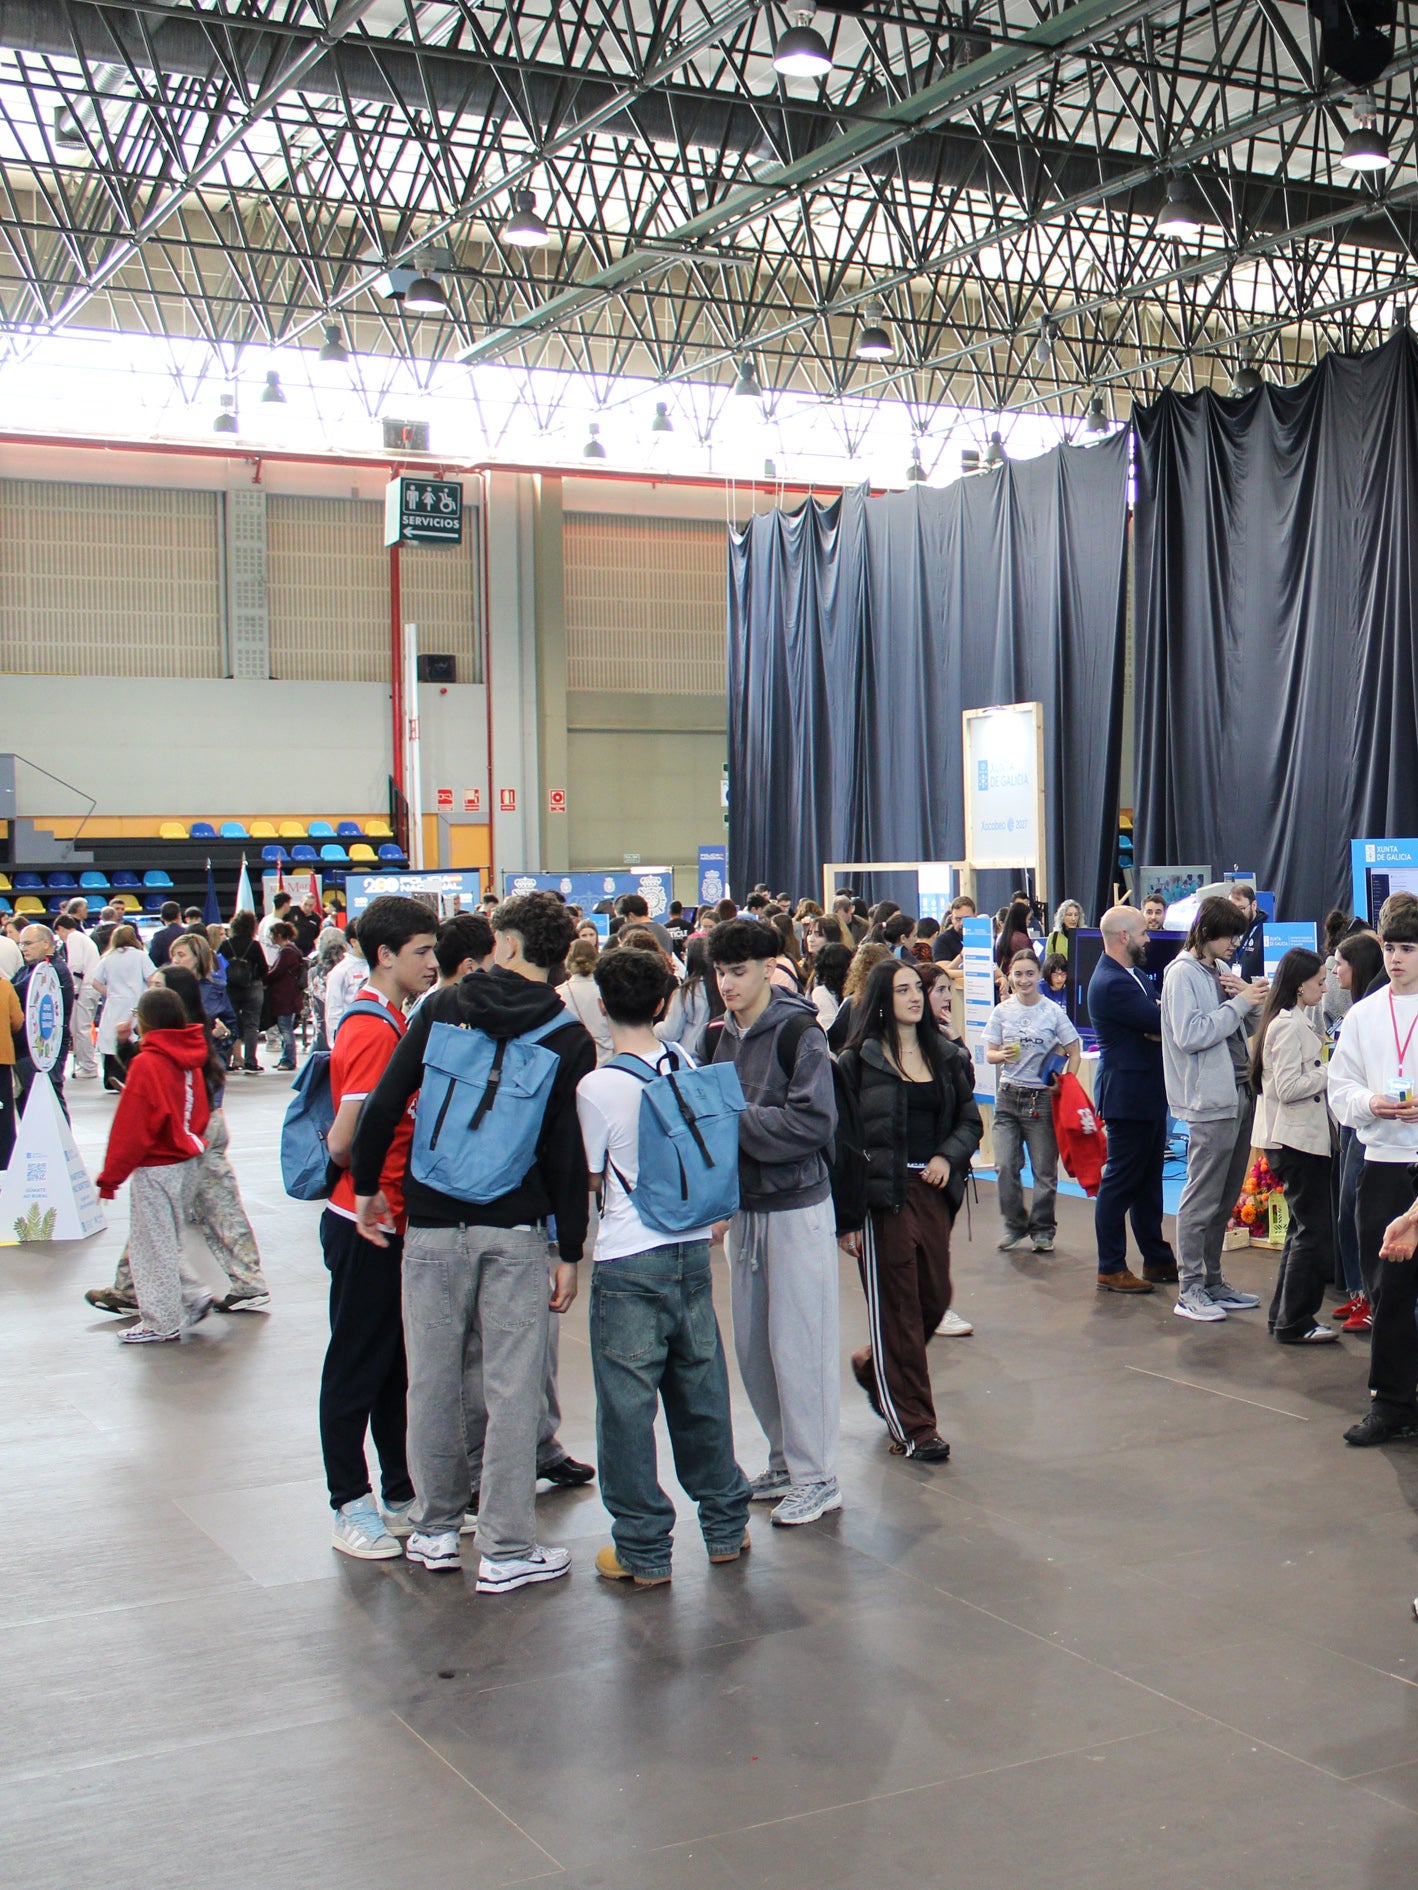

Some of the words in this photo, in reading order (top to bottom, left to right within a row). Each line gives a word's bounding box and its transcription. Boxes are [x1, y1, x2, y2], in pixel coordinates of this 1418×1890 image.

[402, 515, 460, 529] SERVICIOS
[1376, 845, 1399, 853] XUNTA
[1376, 853, 1386, 861] DE
[1387, 853, 1412, 861] GALICIA
